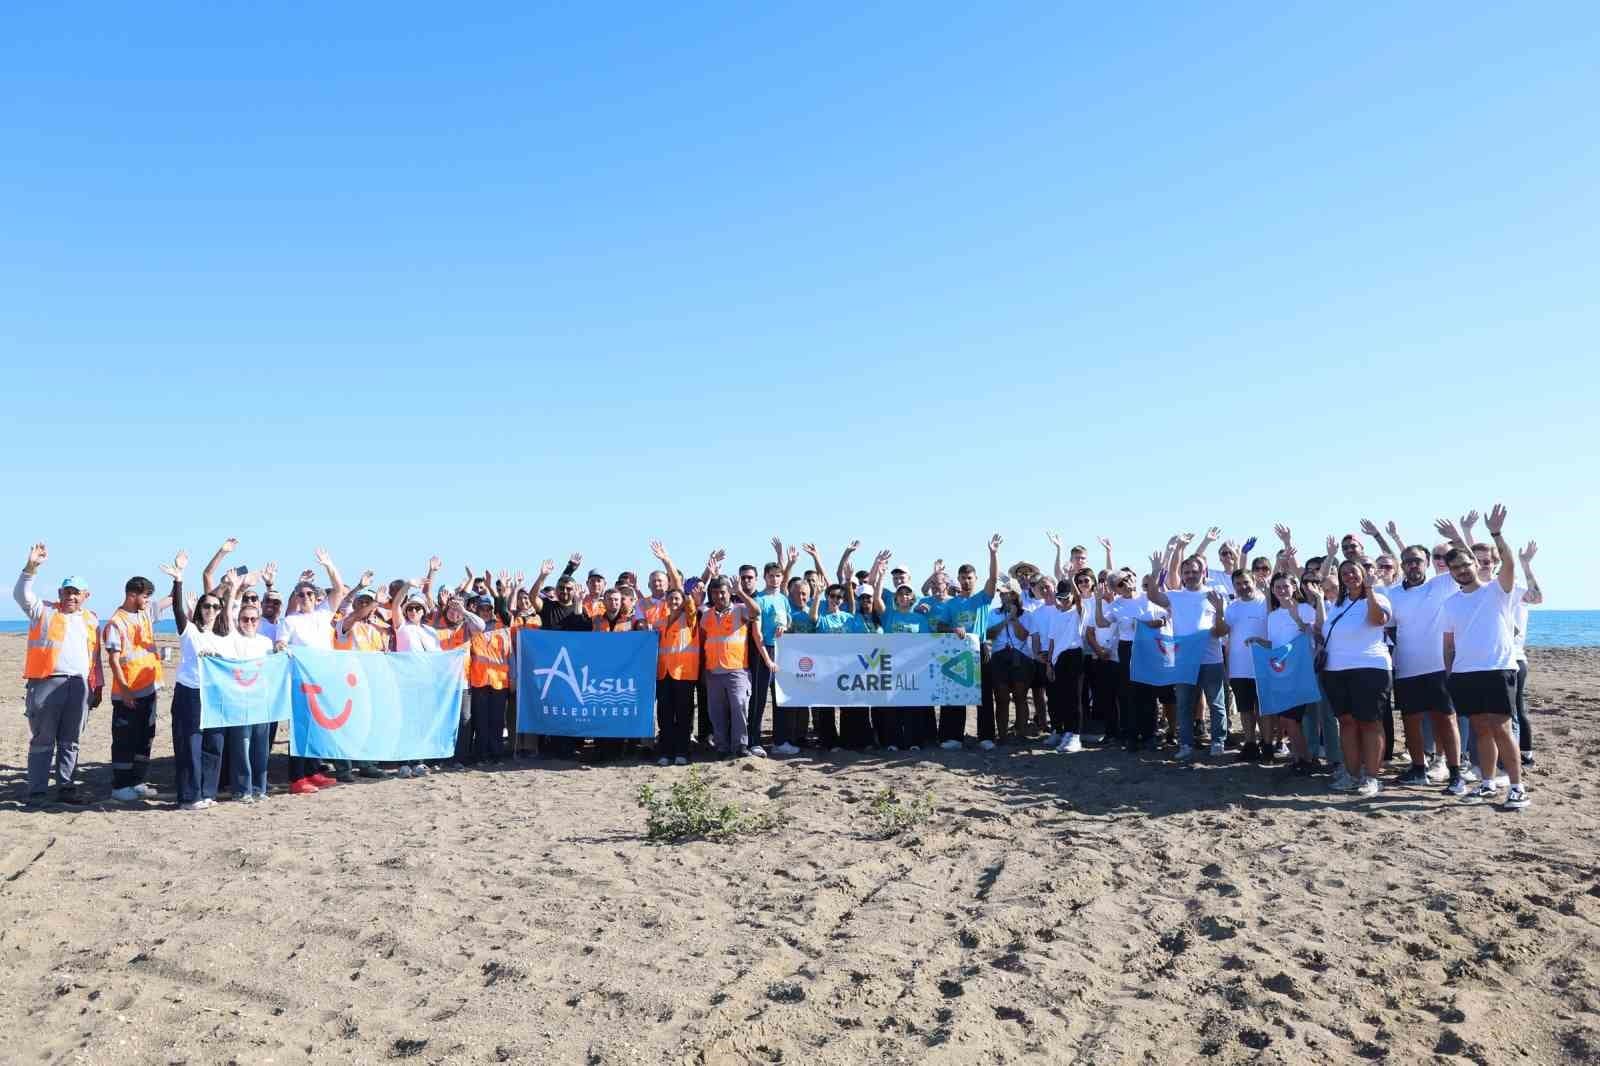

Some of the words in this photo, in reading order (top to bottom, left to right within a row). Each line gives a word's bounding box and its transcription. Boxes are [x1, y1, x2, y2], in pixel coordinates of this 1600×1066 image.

[857, 647, 892, 671] WE
[533, 645, 637, 706] Aksu
[836, 673, 892, 691] CARE
[895, 673, 919, 691] ALL
